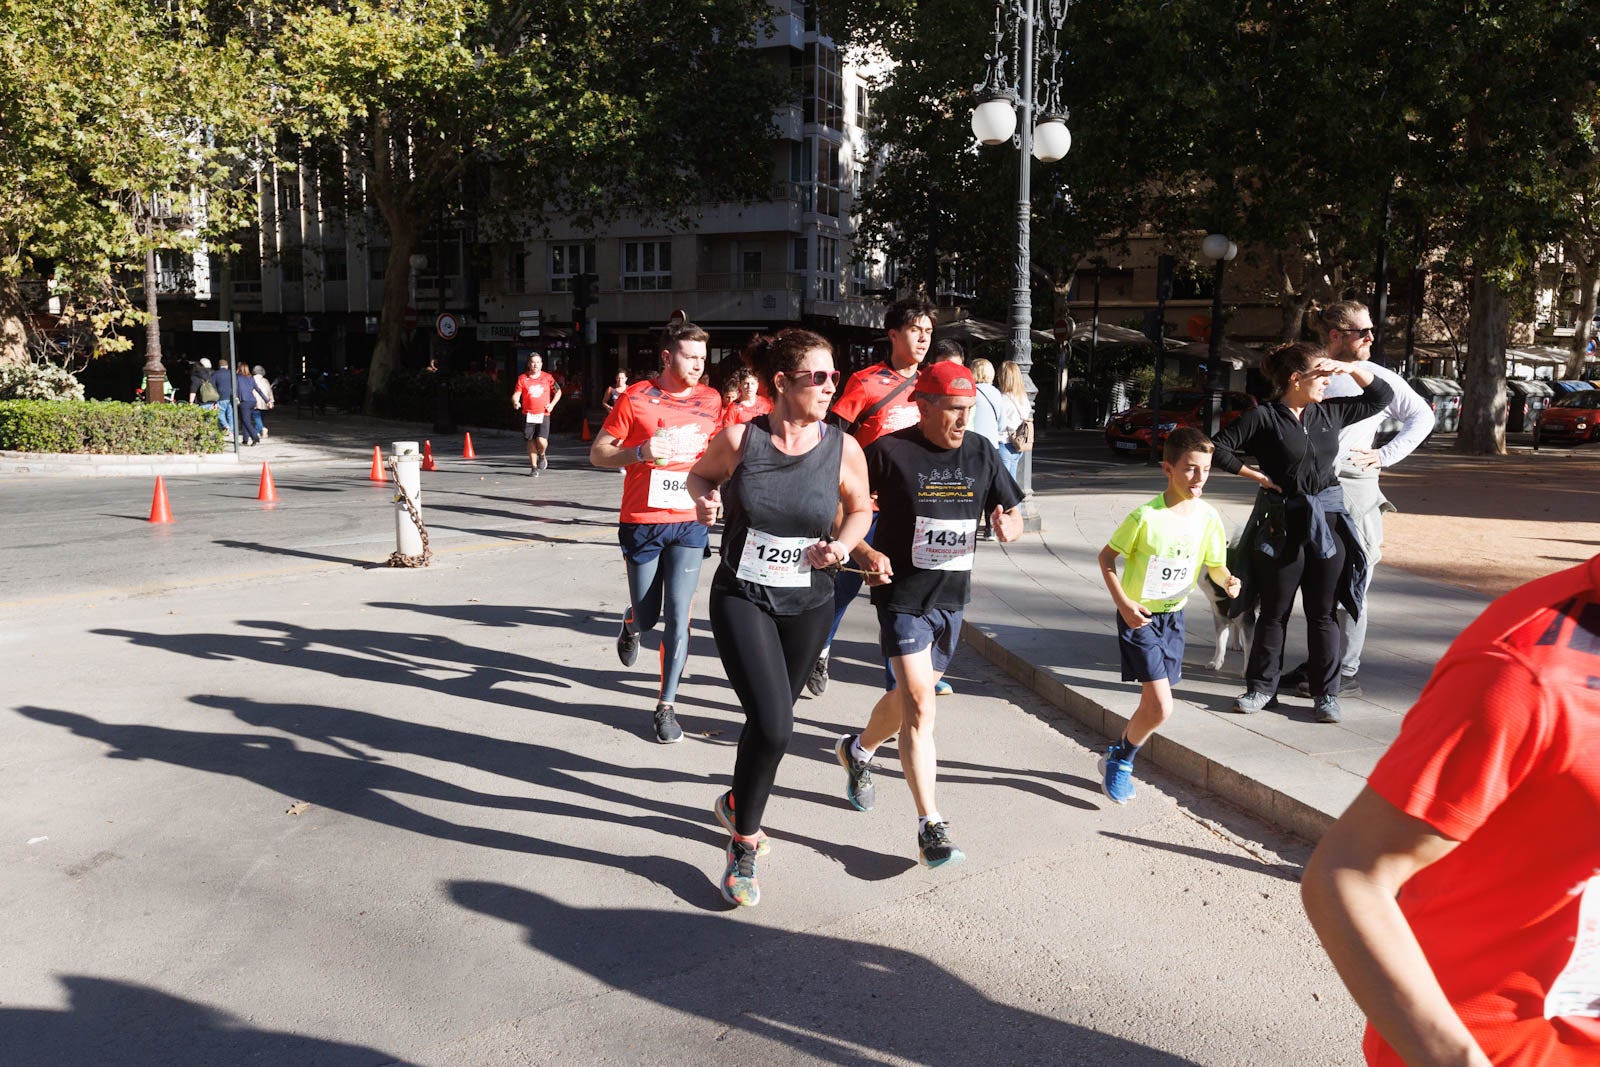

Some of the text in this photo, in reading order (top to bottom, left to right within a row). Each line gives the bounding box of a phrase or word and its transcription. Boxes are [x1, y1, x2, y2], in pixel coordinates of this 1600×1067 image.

[663, 480, 687, 491] 984
[925, 530, 967, 546] 1434
[756, 544, 801, 563] 1299
[1161, 567, 1187, 580] 979
